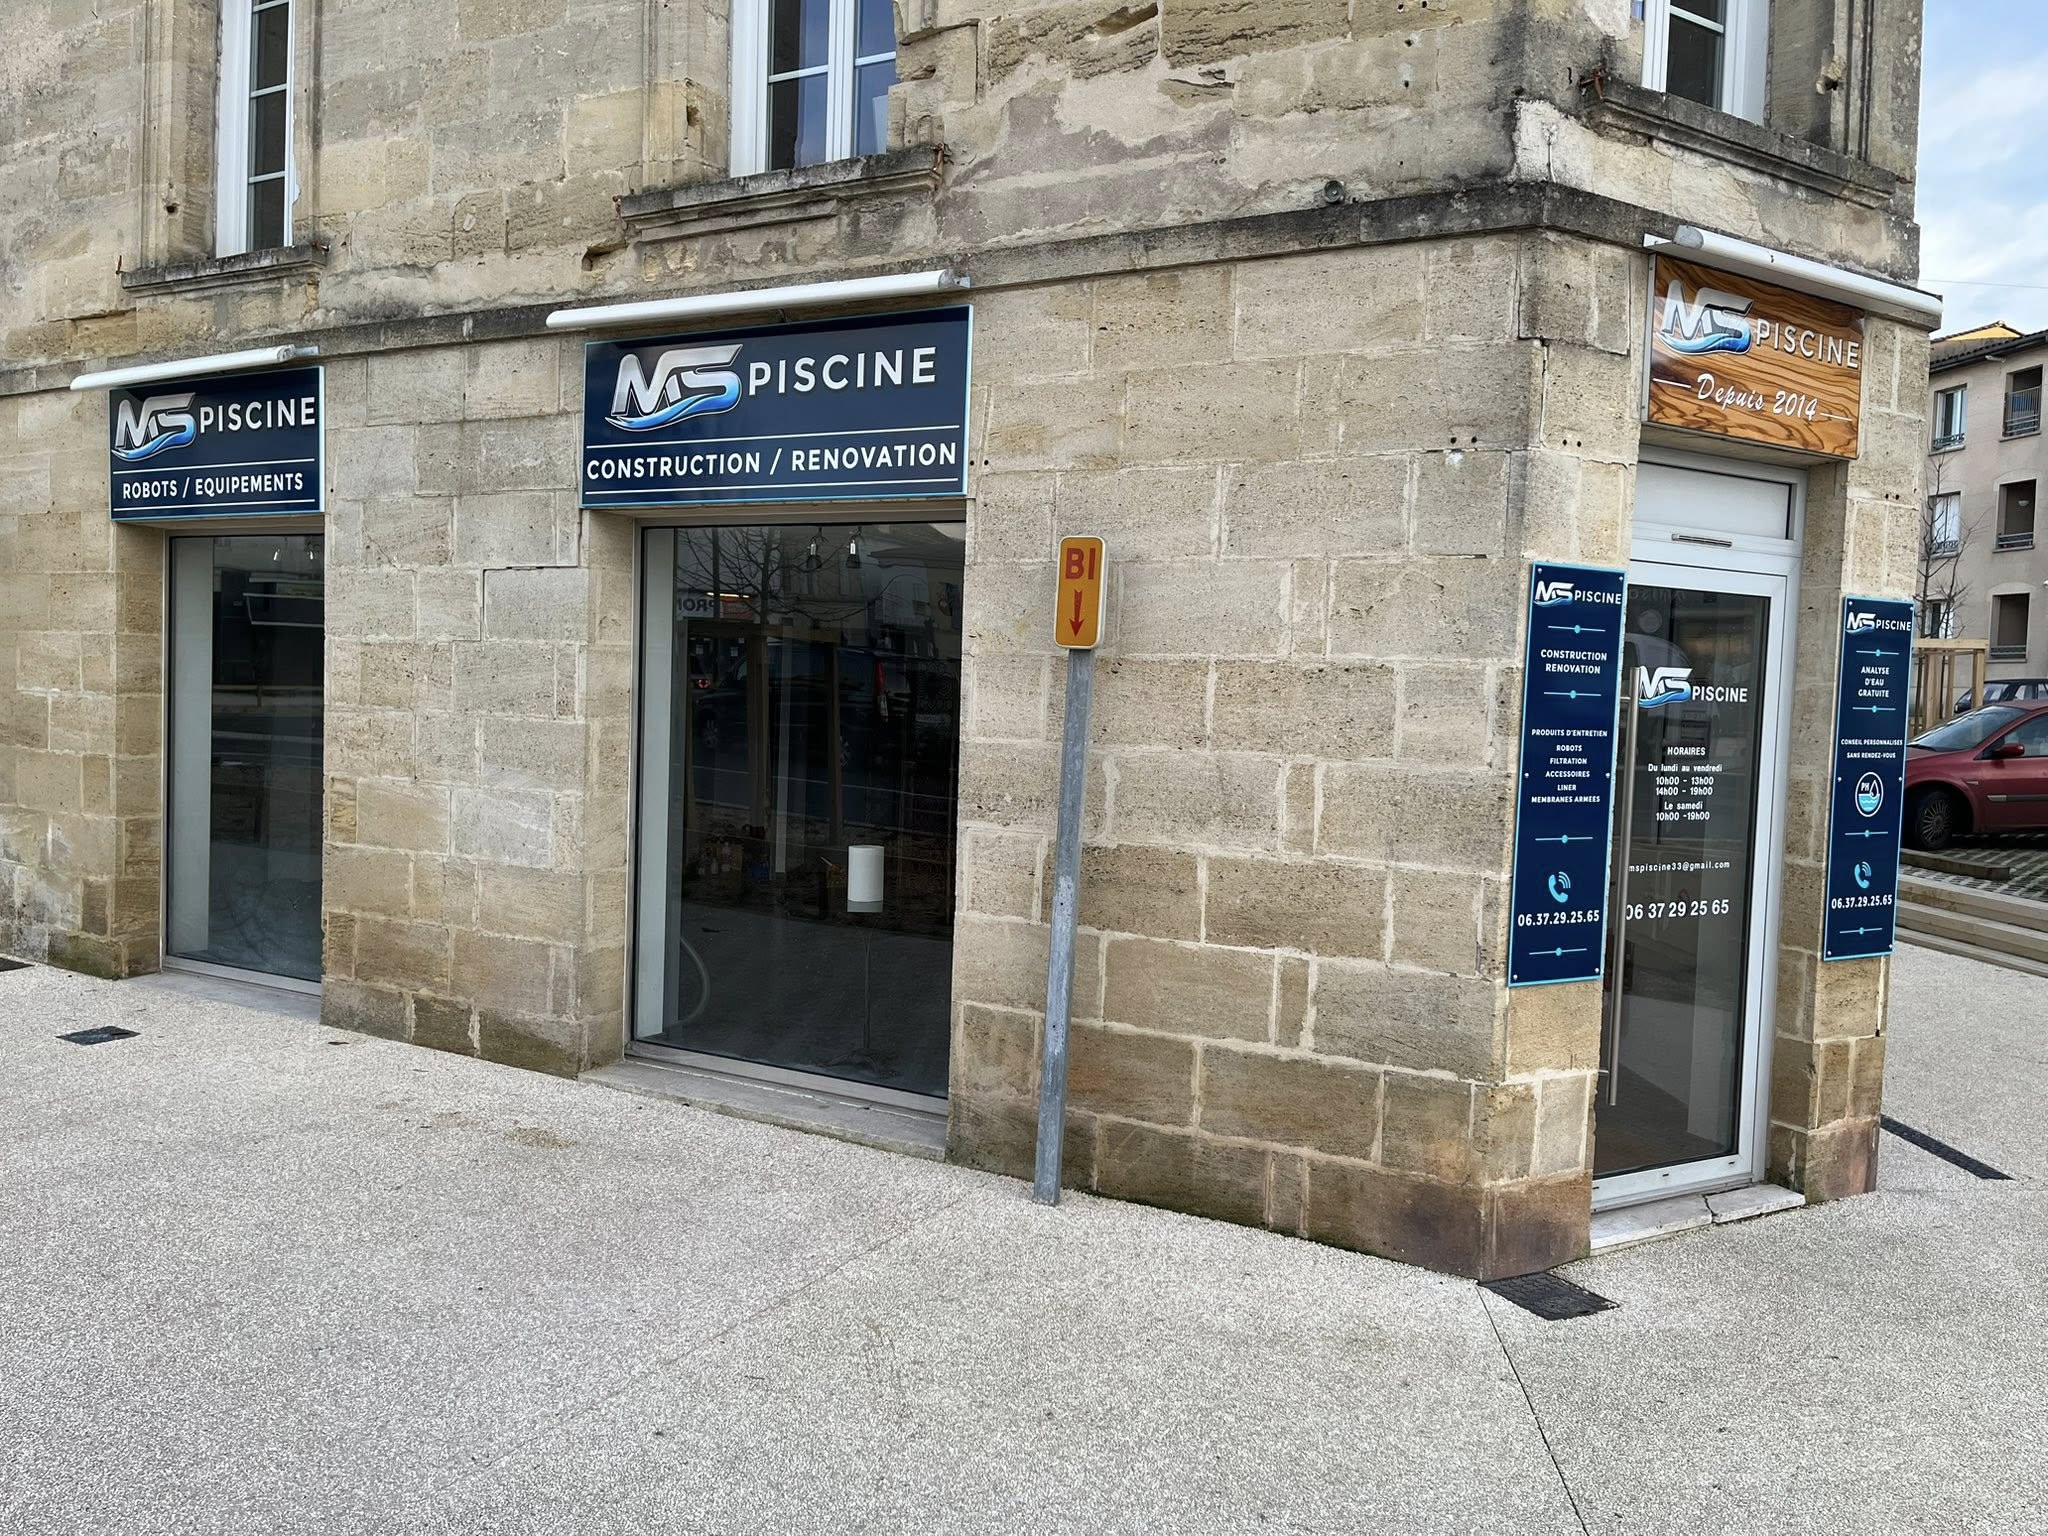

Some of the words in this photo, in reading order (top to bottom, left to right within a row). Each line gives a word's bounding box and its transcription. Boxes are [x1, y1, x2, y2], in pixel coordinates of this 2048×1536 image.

[1656, 279, 1754, 356] MS
[1756, 318, 1860, 369] PISCINE
[605, 343, 743, 432] MS
[748, 346, 937, 396] PISCINE
[1696, 373, 1765, 411] Depuis
[1772, 390, 1818, 421] 2014
[111, 392, 197, 462] MS
[200, 396, 316, 434] PISCINE
[586, 452, 760, 481] CONSTRUCTION
[769, 448, 782, 476] /
[792, 442, 956, 472] RENOVATION
[123, 480, 177, 499] ROBOTS
[196, 472, 303, 498] EQUIPEMENTS
[1065, 547, 1096, 580] BI
[1533, 580, 1574, 607] MS
[1575, 590, 1622, 605] PISCINE
[1846, 611, 1876, 634] MS
[1876, 619, 1912, 632] PISCINE
[1541, 649, 1607, 661] CONSTRUCTION
[1545, 664, 1600, 674] RENOVATION
[1861, 666, 1889, 675] ANALYSE
[1639, 665, 1693, 709] MS
[1692, 685, 1748, 703] PISCINE
[1865, 678, 1884, 686] D'EAU
[1858, 689, 1889, 698] GRATUITE
[1667, 746, 1706, 756] HORAIRES
[1648, 764, 1658, 772] Du
[1661, 764, 1678, 772] lundi
[1656, 776, 1680, 785] 10h00
[1691, 776, 1714, 785] 13h00
[1861, 782, 1870, 792] PH
[1656, 786, 1678, 796] 14h00
[1690, 786, 1713, 796] 19h00
[1664, 802, 1674, 810] Le
[1676, 801, 1703, 810] samedi
[1656, 812, 1680, 821] 10h00
[1628, 860, 1730, 874] mspiscine33@gmail.com
[1626, 904, 1644, 920] 06
[1648, 902, 1666, 918] 37
[1668, 901, 1686, 917] 29
[1690, 900, 1708, 916] 25
[1712, 899, 1730, 914] 65
[1831, 894, 1893, 910] 06.37.29.25.65
[1517, 909, 1600, 927] 06.37.29.25.65
